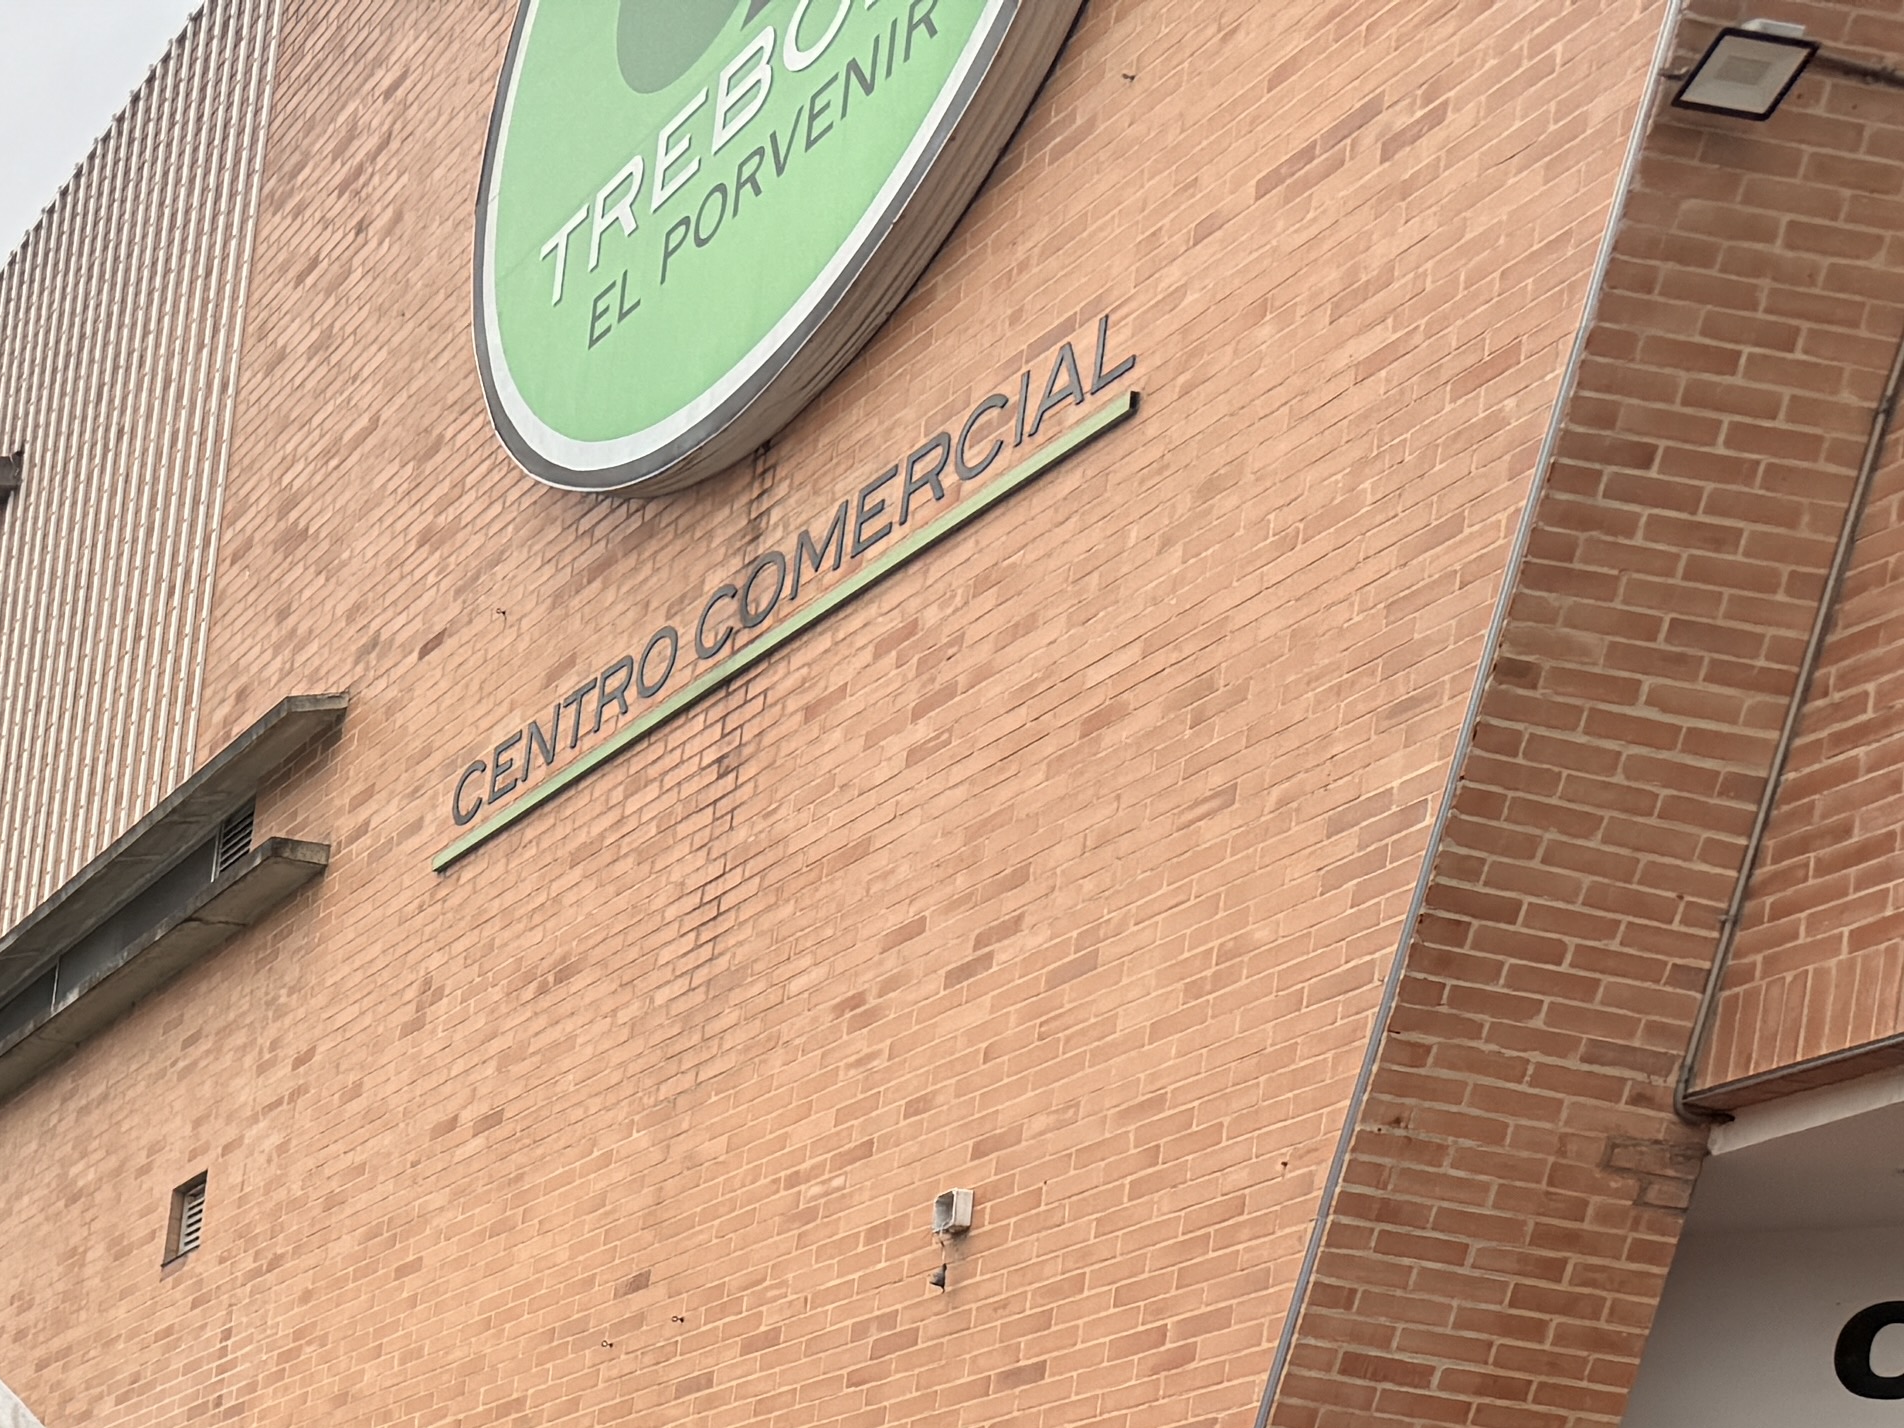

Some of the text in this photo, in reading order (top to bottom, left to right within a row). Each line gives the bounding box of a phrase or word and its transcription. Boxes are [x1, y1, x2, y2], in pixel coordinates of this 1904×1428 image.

[539, 0, 877, 307] TREBO
[587, 0, 939, 350] EL PORVENIR
[451, 314, 1136, 826] CENTRO COMERCIAL
